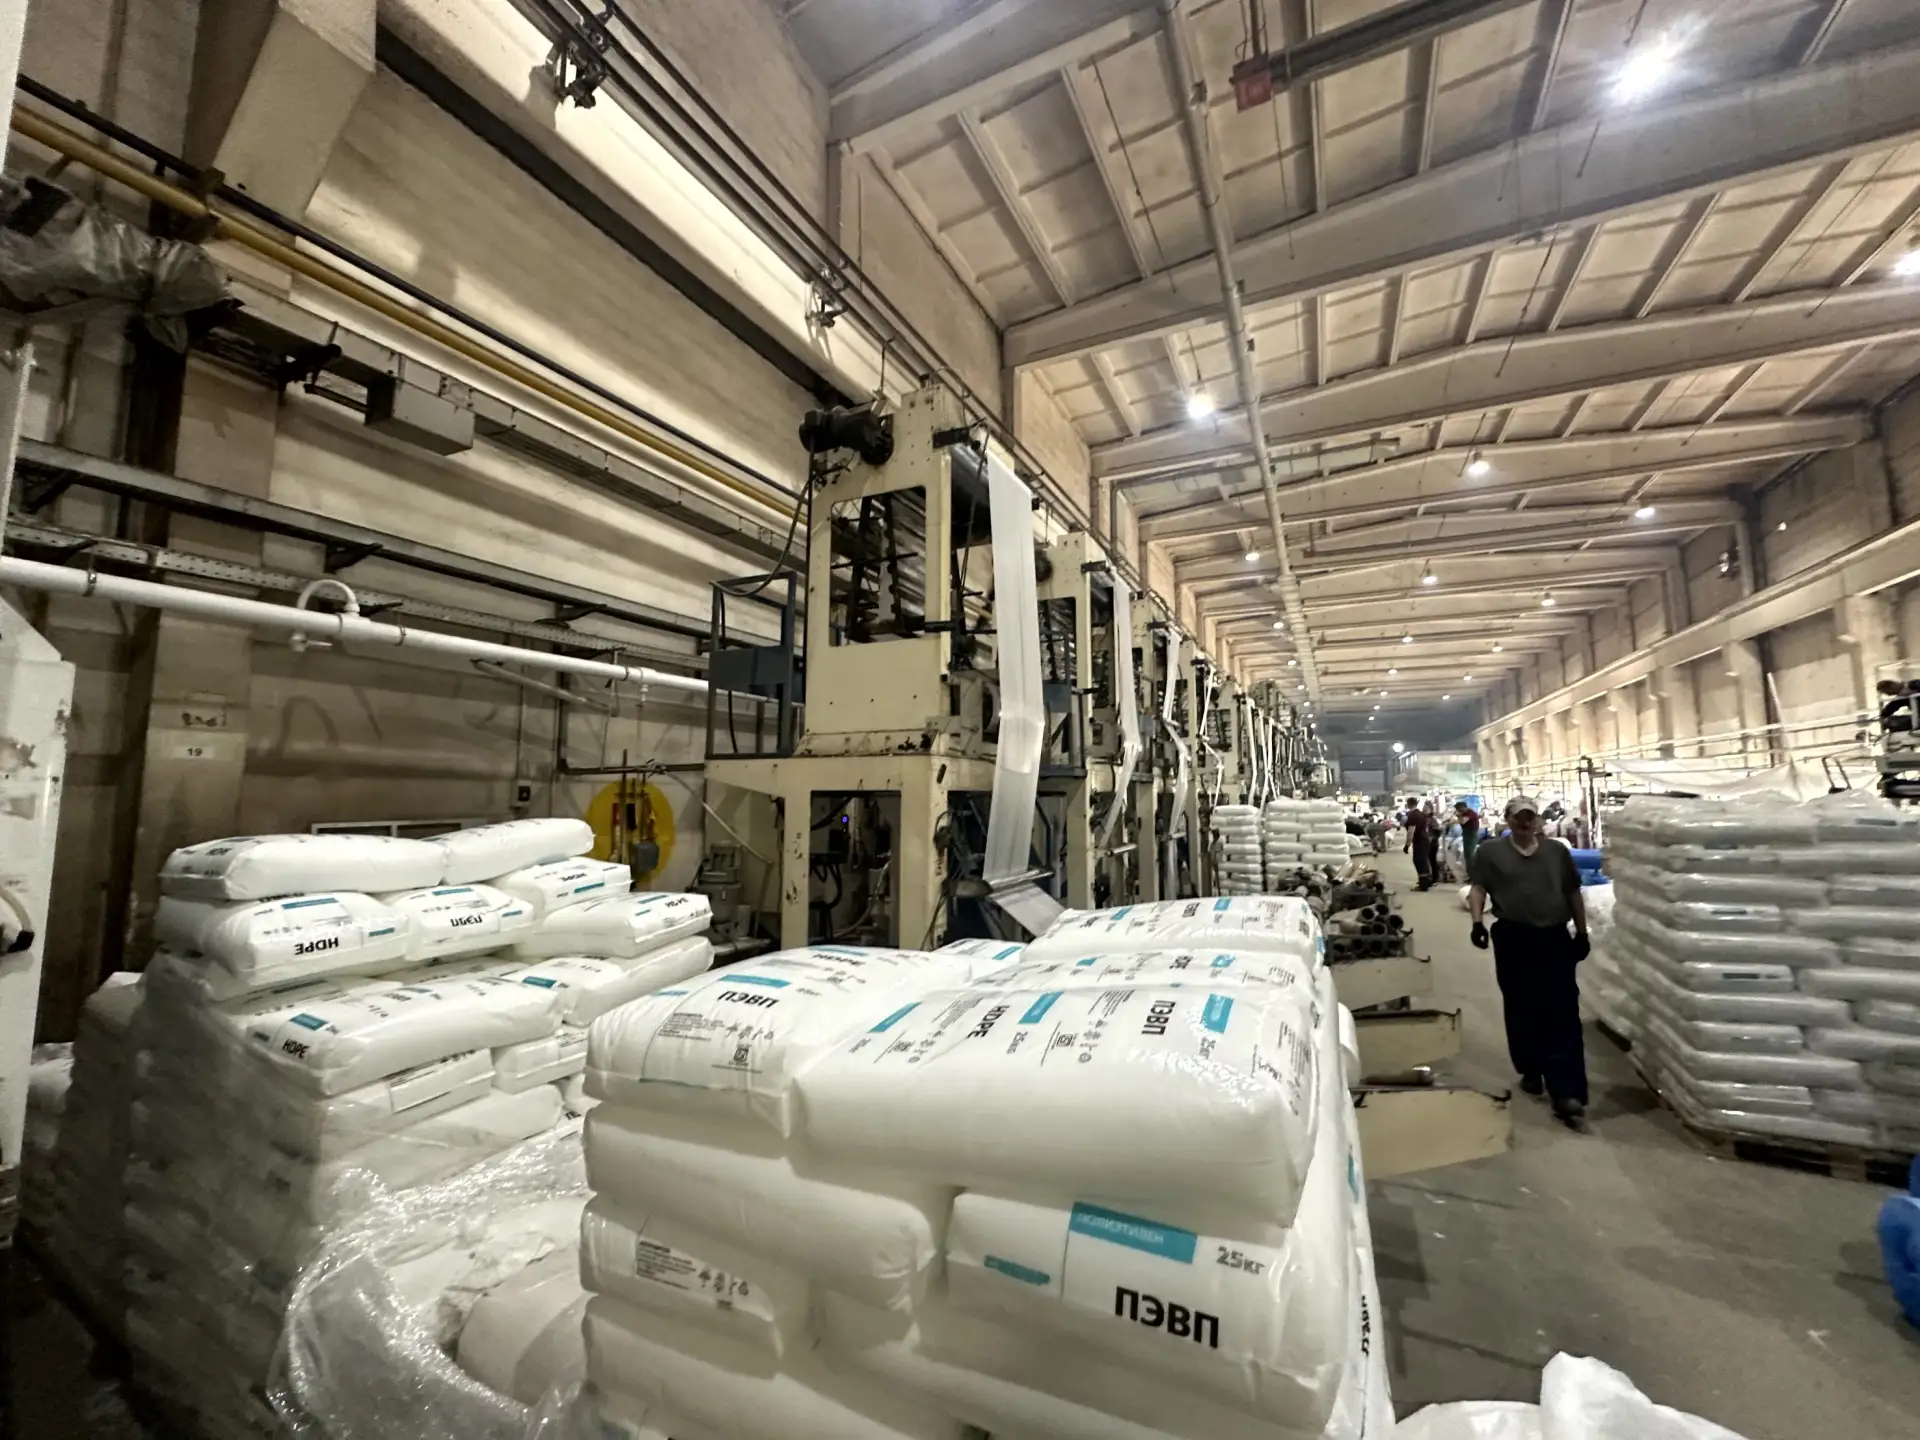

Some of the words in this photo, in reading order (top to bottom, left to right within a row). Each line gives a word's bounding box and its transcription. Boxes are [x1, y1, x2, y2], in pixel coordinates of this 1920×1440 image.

[187, 747, 203, 757] 19
[294, 937, 339, 955] HDPE
[717, 990, 780, 1008] ПЭВП
[965, 1004, 1010, 1039] HDPE
[1141, 999, 1176, 1035] ПЭВП
[282, 1038, 310, 1059] HDPE
[1216, 1246, 1266, 1275] 25кг
[1114, 1285, 1220, 1349] ПЭВП
